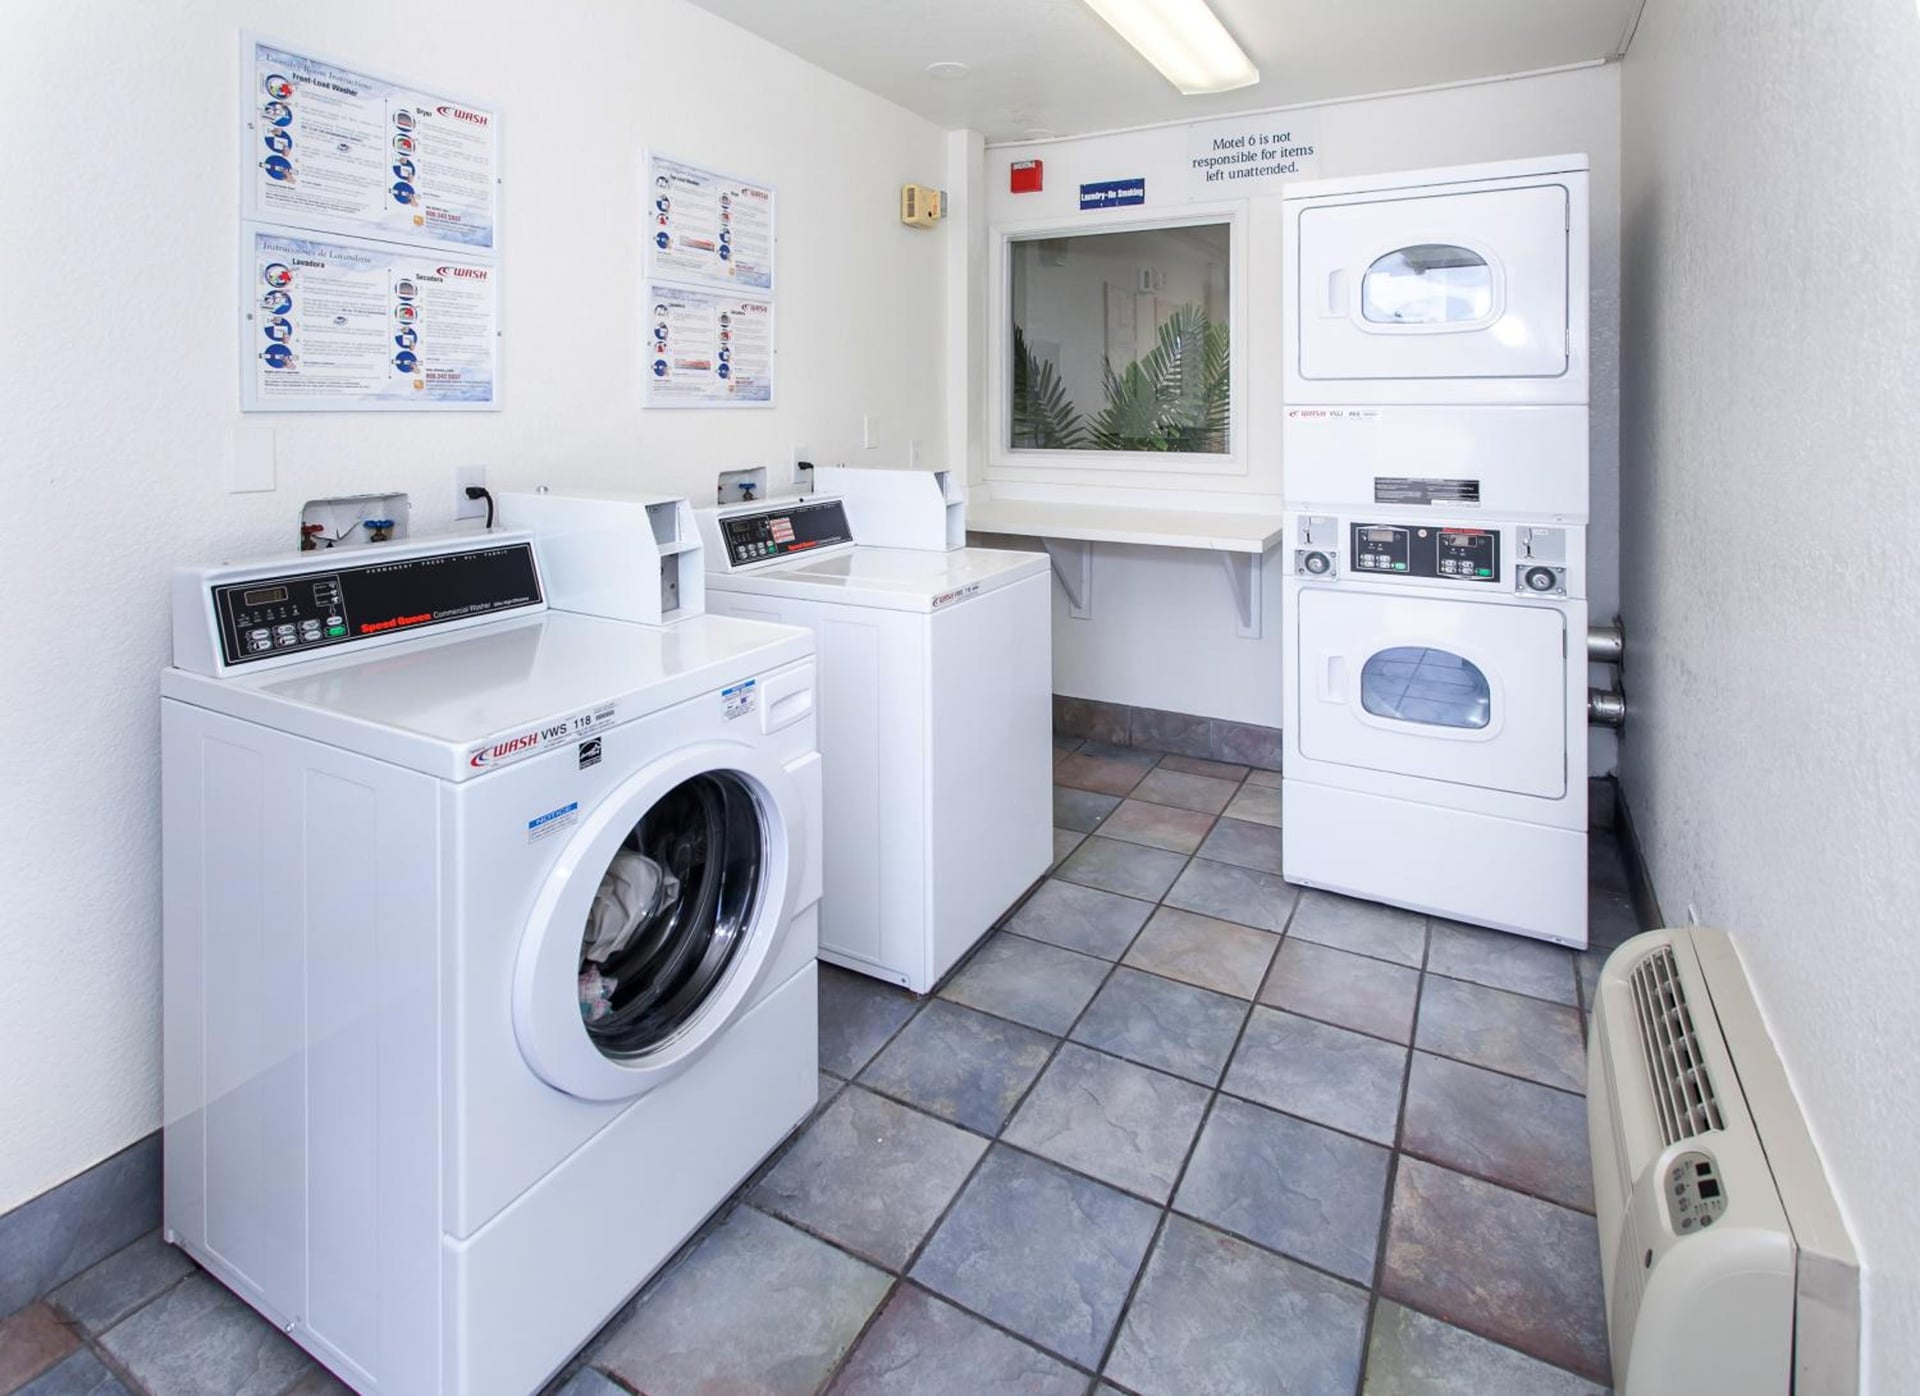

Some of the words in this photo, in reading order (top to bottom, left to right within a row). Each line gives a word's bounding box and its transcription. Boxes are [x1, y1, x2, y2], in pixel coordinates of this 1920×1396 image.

[292, 72, 330, 89] Front-Load
[332, 83, 358, 97] Washer
[453, 109, 488, 125] WASH
[1212, 135, 1245, 151] Motel
[1248, 135, 1256, 146] 6
[1259, 133, 1269, 145] is
[1272, 132, 1291, 143] not
[1192, 151, 1258, 169] responsible
[1261, 148, 1277, 161] for
[1280, 146, 1314, 158] items
[1206, 168, 1224, 182] left
[1228, 161, 1299, 180] unattended.
[292, 258, 325, 269] Lavadora
[453, 267, 488, 280] WASH
[415, 273, 443, 283] Secadora
[361, 617, 397, 634] Speed
[397, 612, 432, 627] Queen
[433, 605, 470, 619] Commercial
[470, 601, 491, 612] Washer
[494, 733, 538, 758] WASH
[541, 723, 567, 741] VWS
[574, 715, 591, 729] 118
